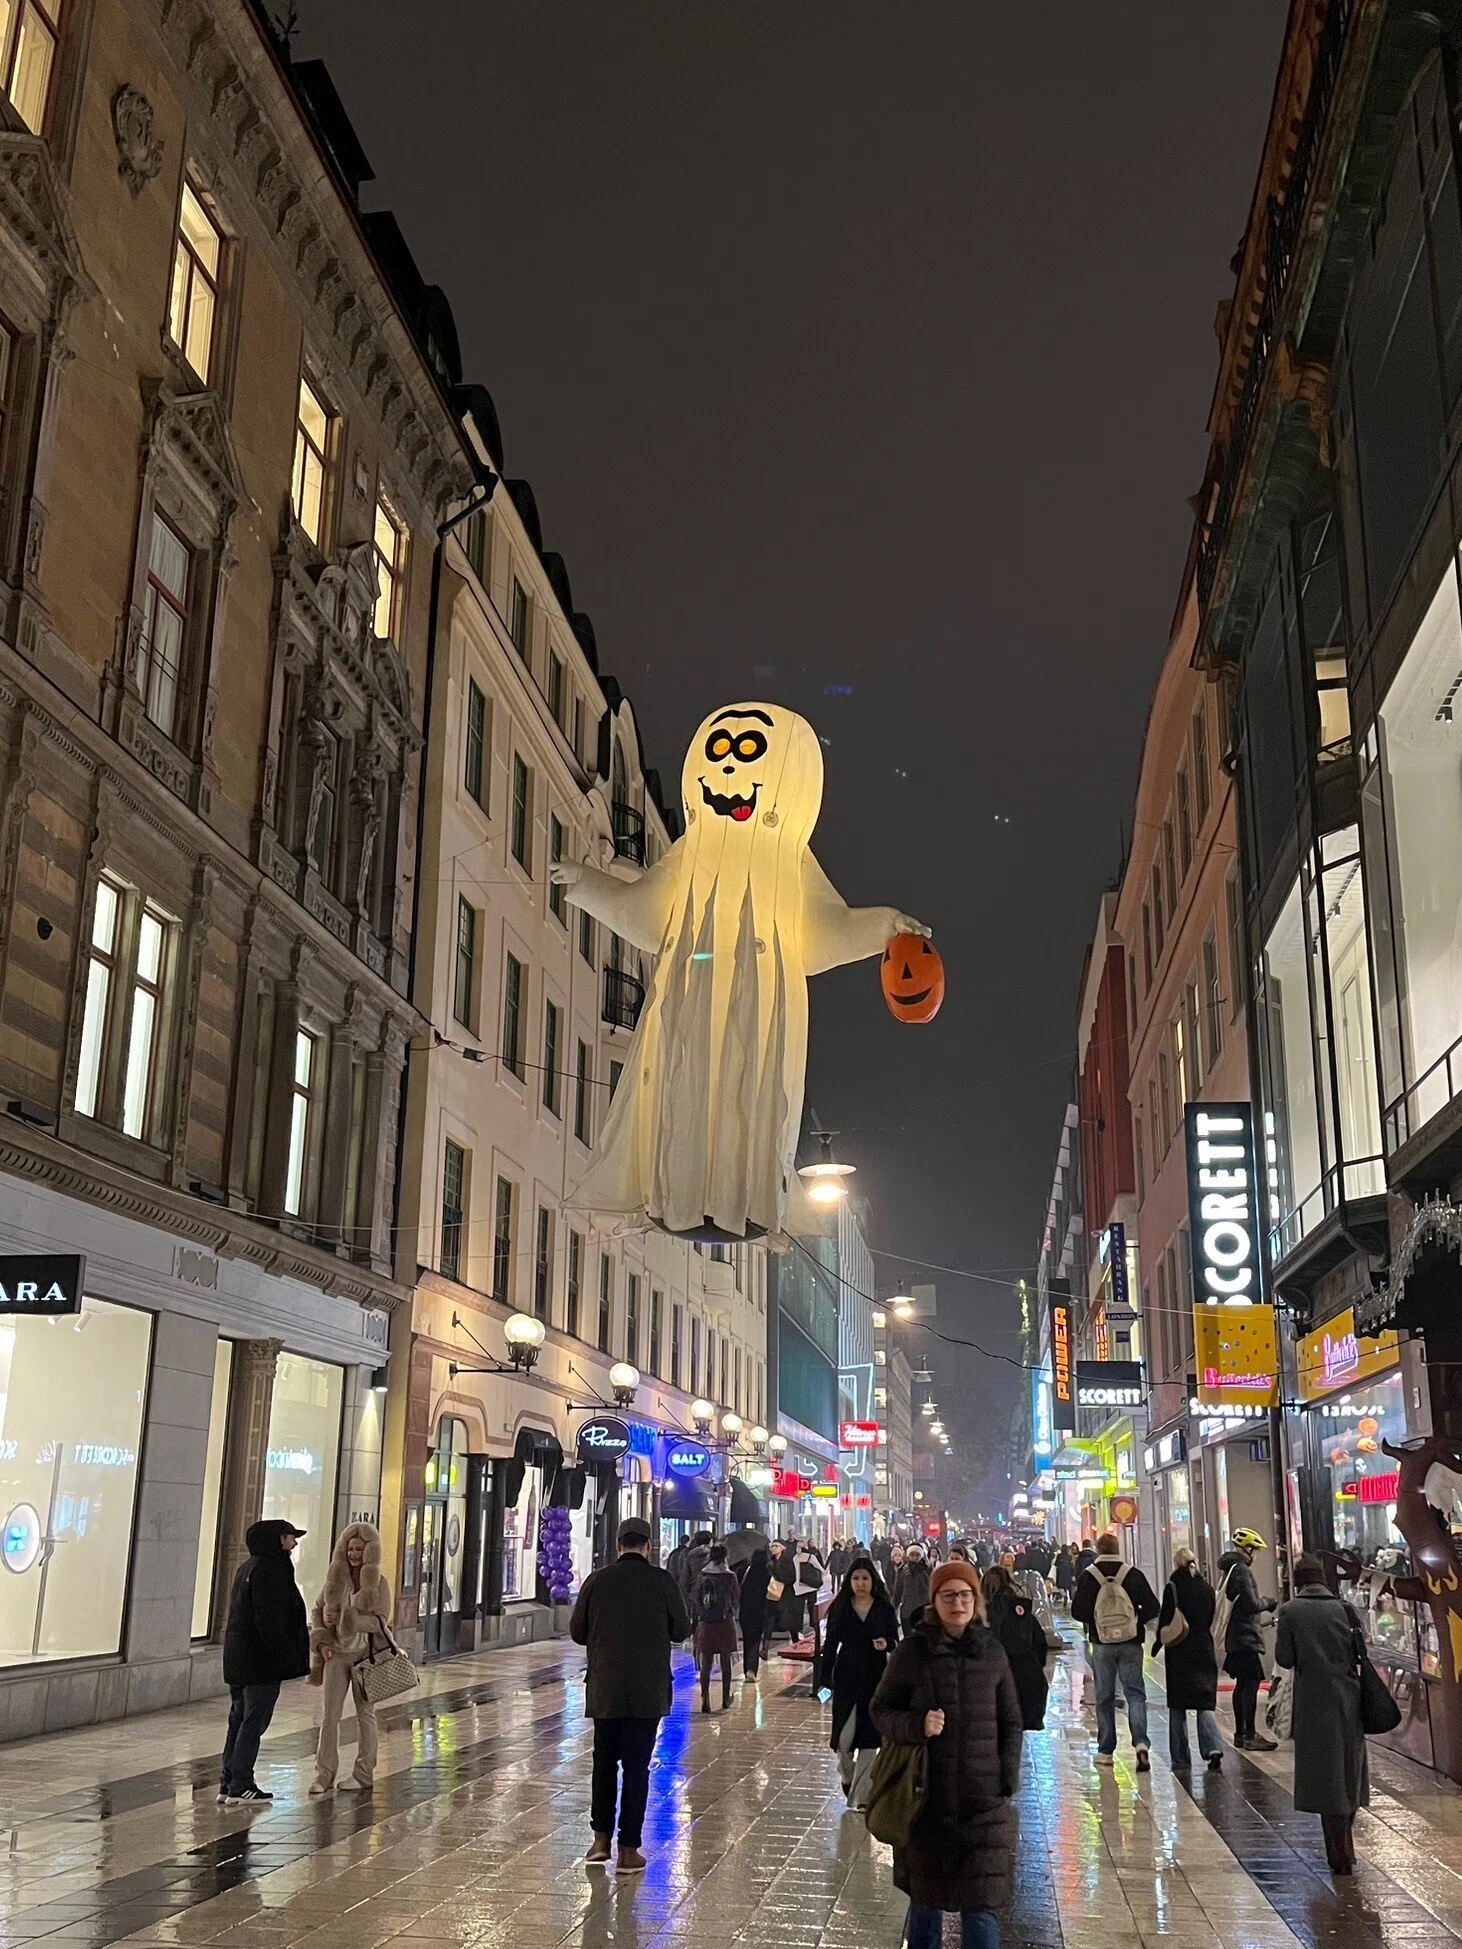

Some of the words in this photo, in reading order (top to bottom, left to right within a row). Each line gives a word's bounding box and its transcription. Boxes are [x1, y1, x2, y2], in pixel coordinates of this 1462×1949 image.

[1054, 1306, 1070, 1401] POWER
[1078, 1387, 1141, 1405] SCORETT
[582, 1426, 627, 1446] Rizzo
[672, 1454, 705, 1466] SALT
[351, 1512, 375, 1523] ZARA
